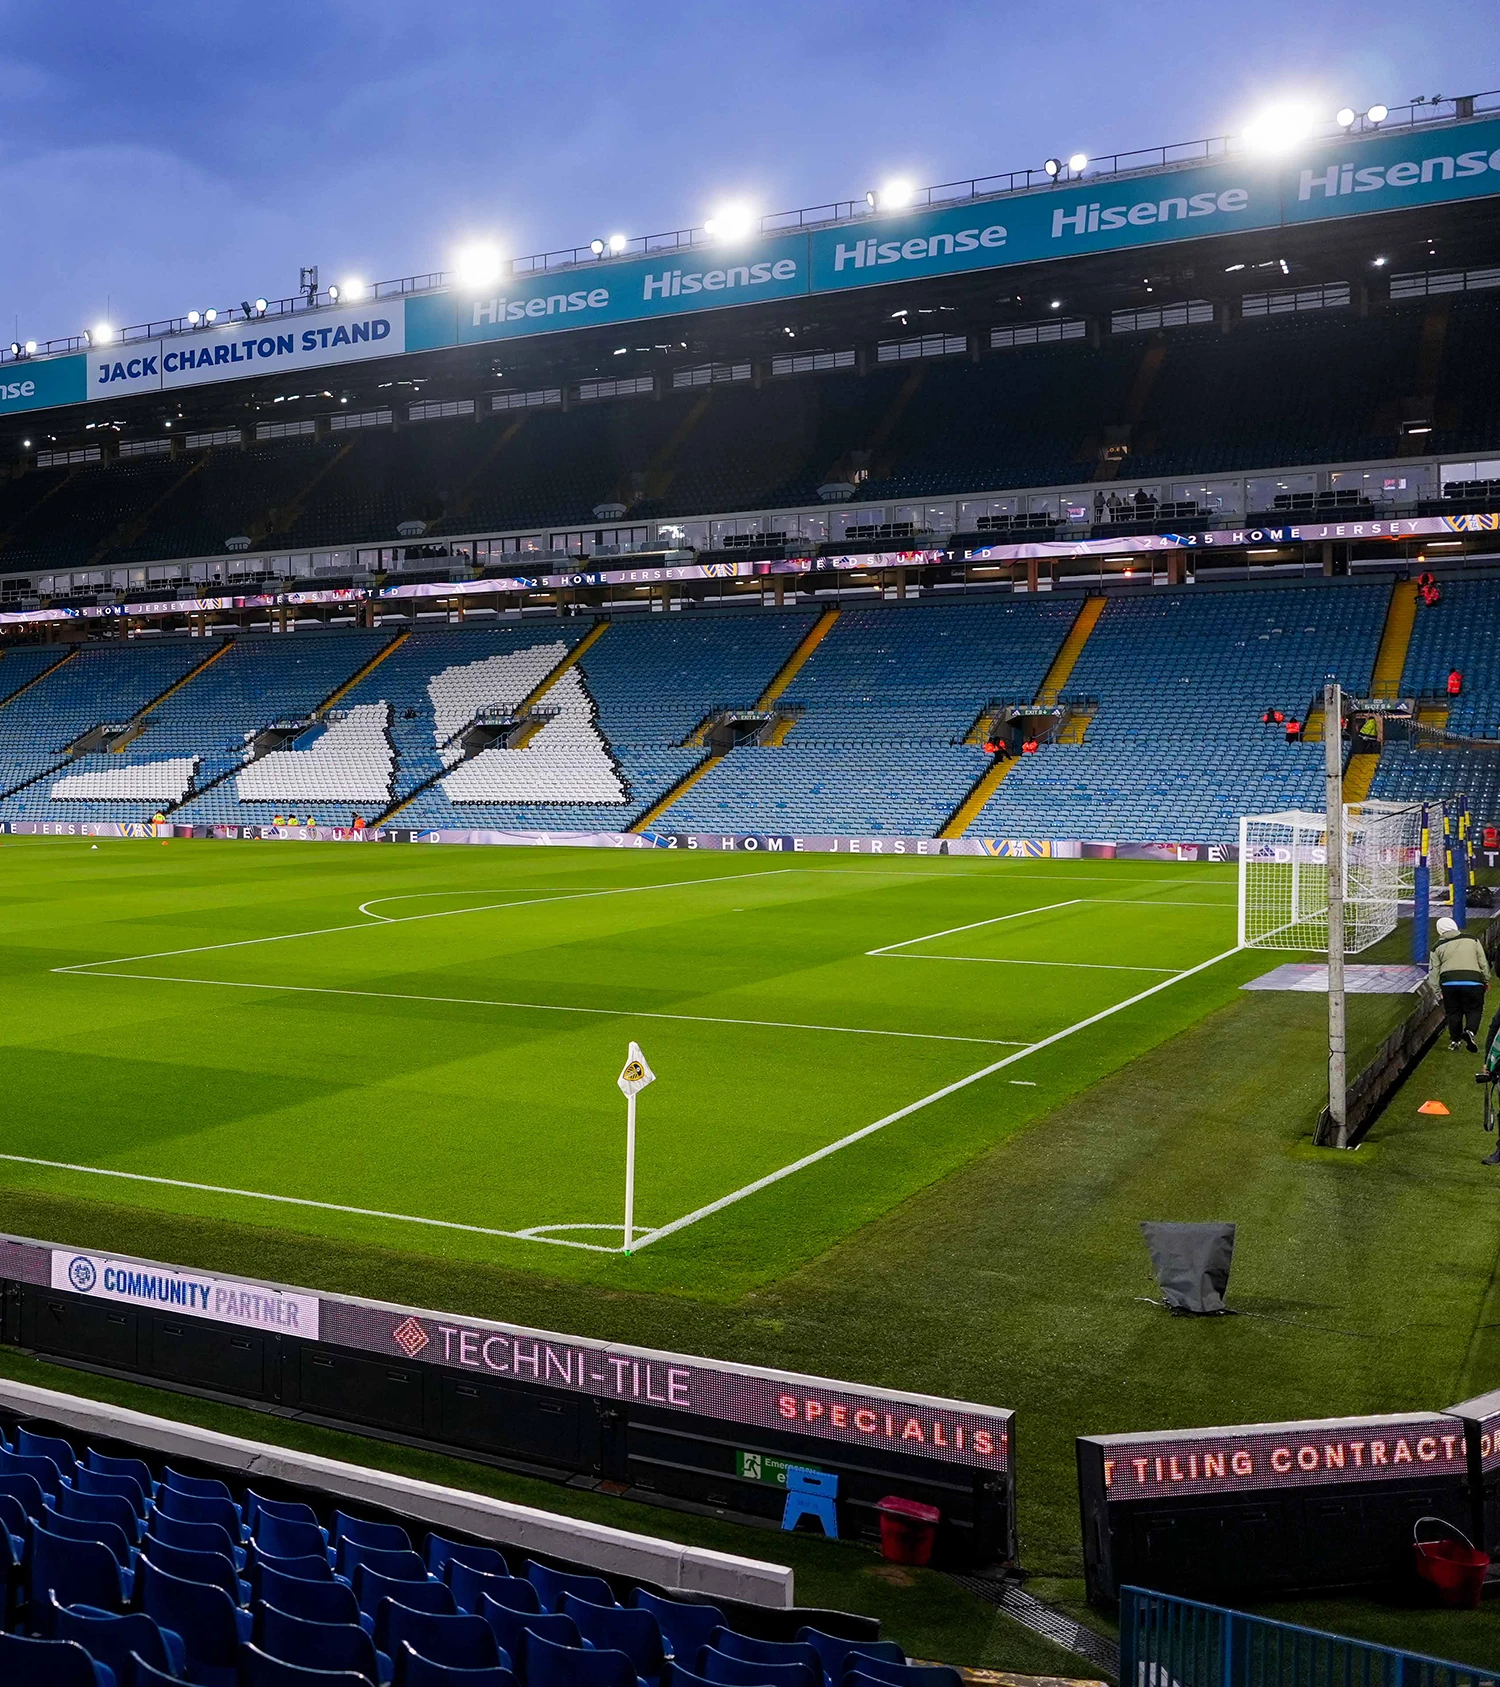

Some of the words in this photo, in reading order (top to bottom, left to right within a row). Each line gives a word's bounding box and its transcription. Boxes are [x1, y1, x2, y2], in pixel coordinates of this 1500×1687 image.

[1051, 187, 1248, 238] Hisense
[834, 225, 1008, 271] Hisense
[643, 258, 796, 300] Hisense
[473, 288, 609, 326] Hisense
[98, 355, 159, 384] JACK
[163, 333, 295, 372] CHARLTON
[302, 318, 391, 351] STAND
[1143, 533, 1214, 548] 24/25
[1233, 528, 1300, 542] HOME
[1320, 521, 1419, 536] JERSEY
[801, 555, 874, 570] LEEDS
[897, 548, 992, 564] UNITED
[501, 577, 549, 589] 24/25
[561, 573, 607, 586] HOME
[619, 568, 686, 581] JERSEY
[53, 609, 88, 618] 24/25
[96, 606, 130, 615] HOME
[138, 602, 186, 613] JERSEY
[266, 592, 318, 604] LEEDS
[332, 588, 399, 599] UNITED
[31, 823, 102, 836] JERSEY
[227, 826, 307, 839] LEEDS
[332, 827, 441, 844] UNITED
[614, 835, 698, 849] 24/25
[722, 837, 804, 852] HOME
[103, 1266, 211, 1311] COMMUNITY
[215, 1287, 300, 1329] PARTNER
[437, 1326, 691, 1407] TECHNI-TILE
[1132, 1450, 1253, 1484] TILING
[1271, 1434, 1467, 1474] CONTRACT
